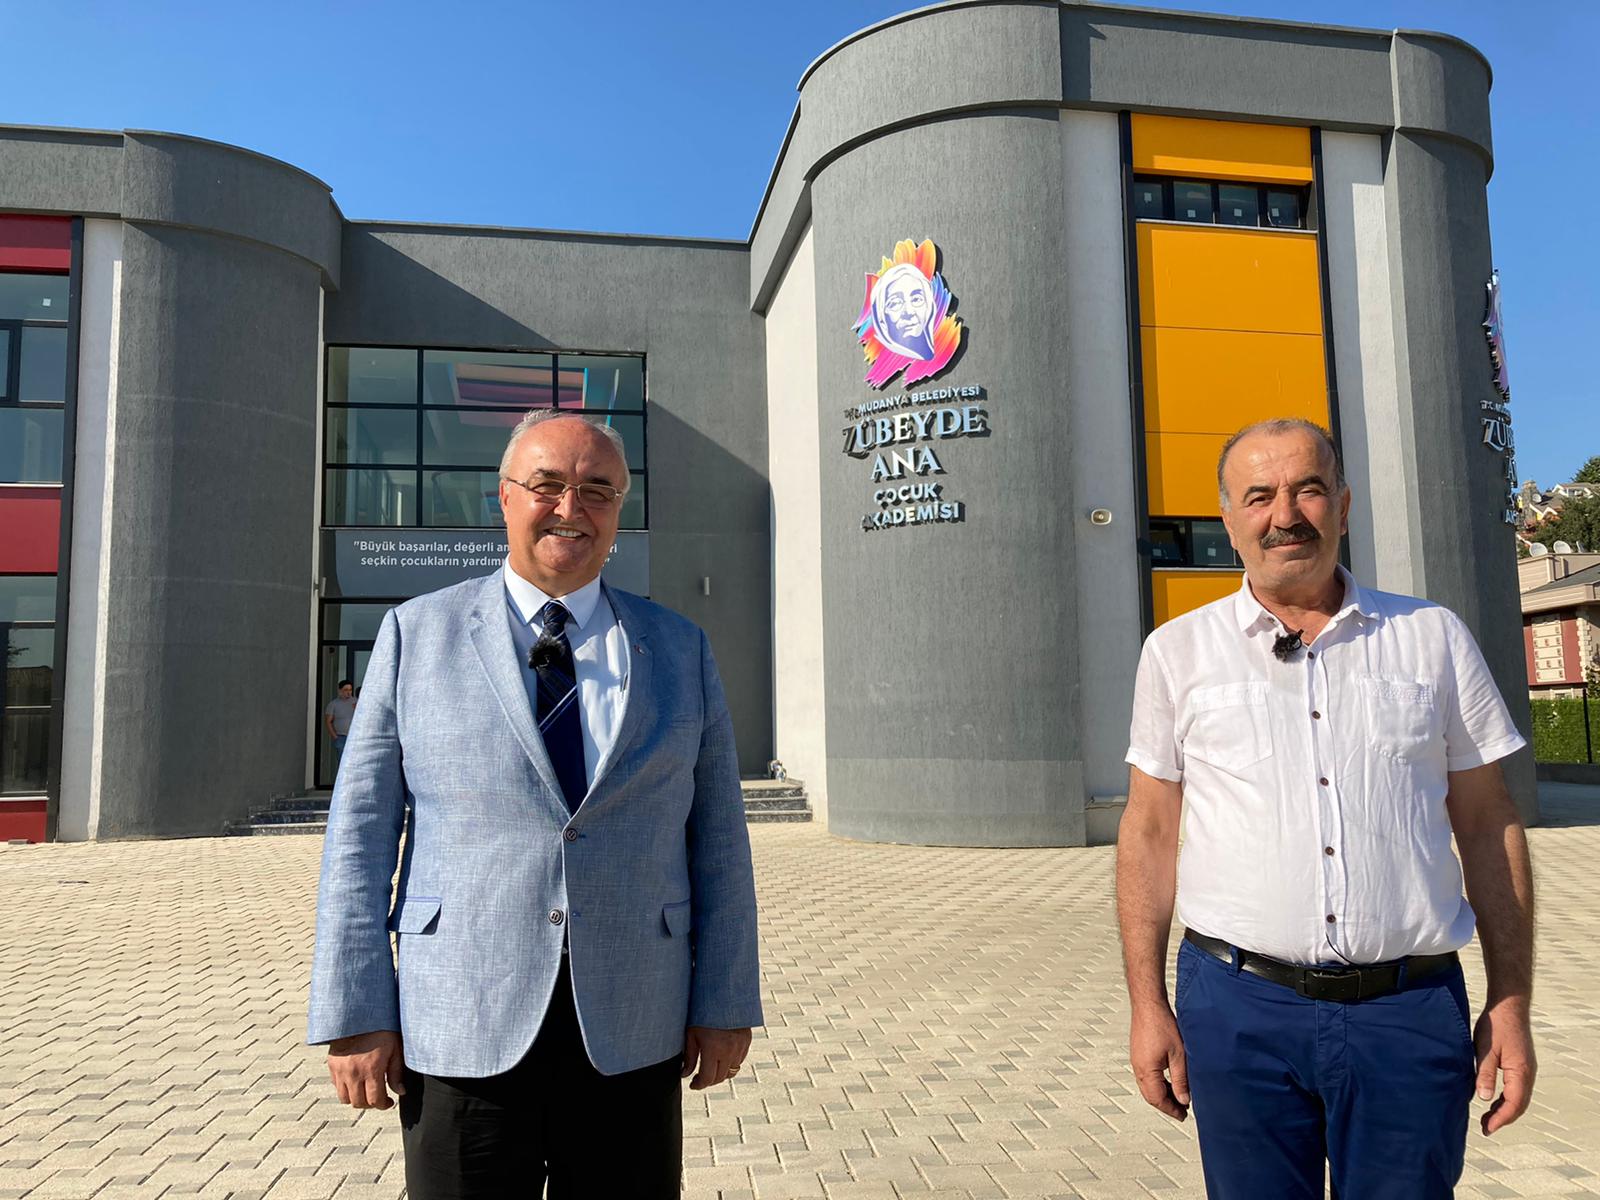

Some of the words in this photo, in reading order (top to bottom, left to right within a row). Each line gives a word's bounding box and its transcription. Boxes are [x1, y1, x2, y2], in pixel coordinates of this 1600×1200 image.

[859, 394, 908, 413] MUDANYA
[911, 384, 979, 403] BELEDİYESİ
[842, 405, 984, 456] ZÜBEYDE
[870, 445, 942, 480] ANA
[873, 481, 938, 506] ÇOCUK
[399, 541, 451, 553] başarılar,
[453, 541, 494, 553] değerli
[360, 555, 398, 567] seçkin
[400, 555, 459, 567] çocukların
[462, 556, 505, 568] yardım
